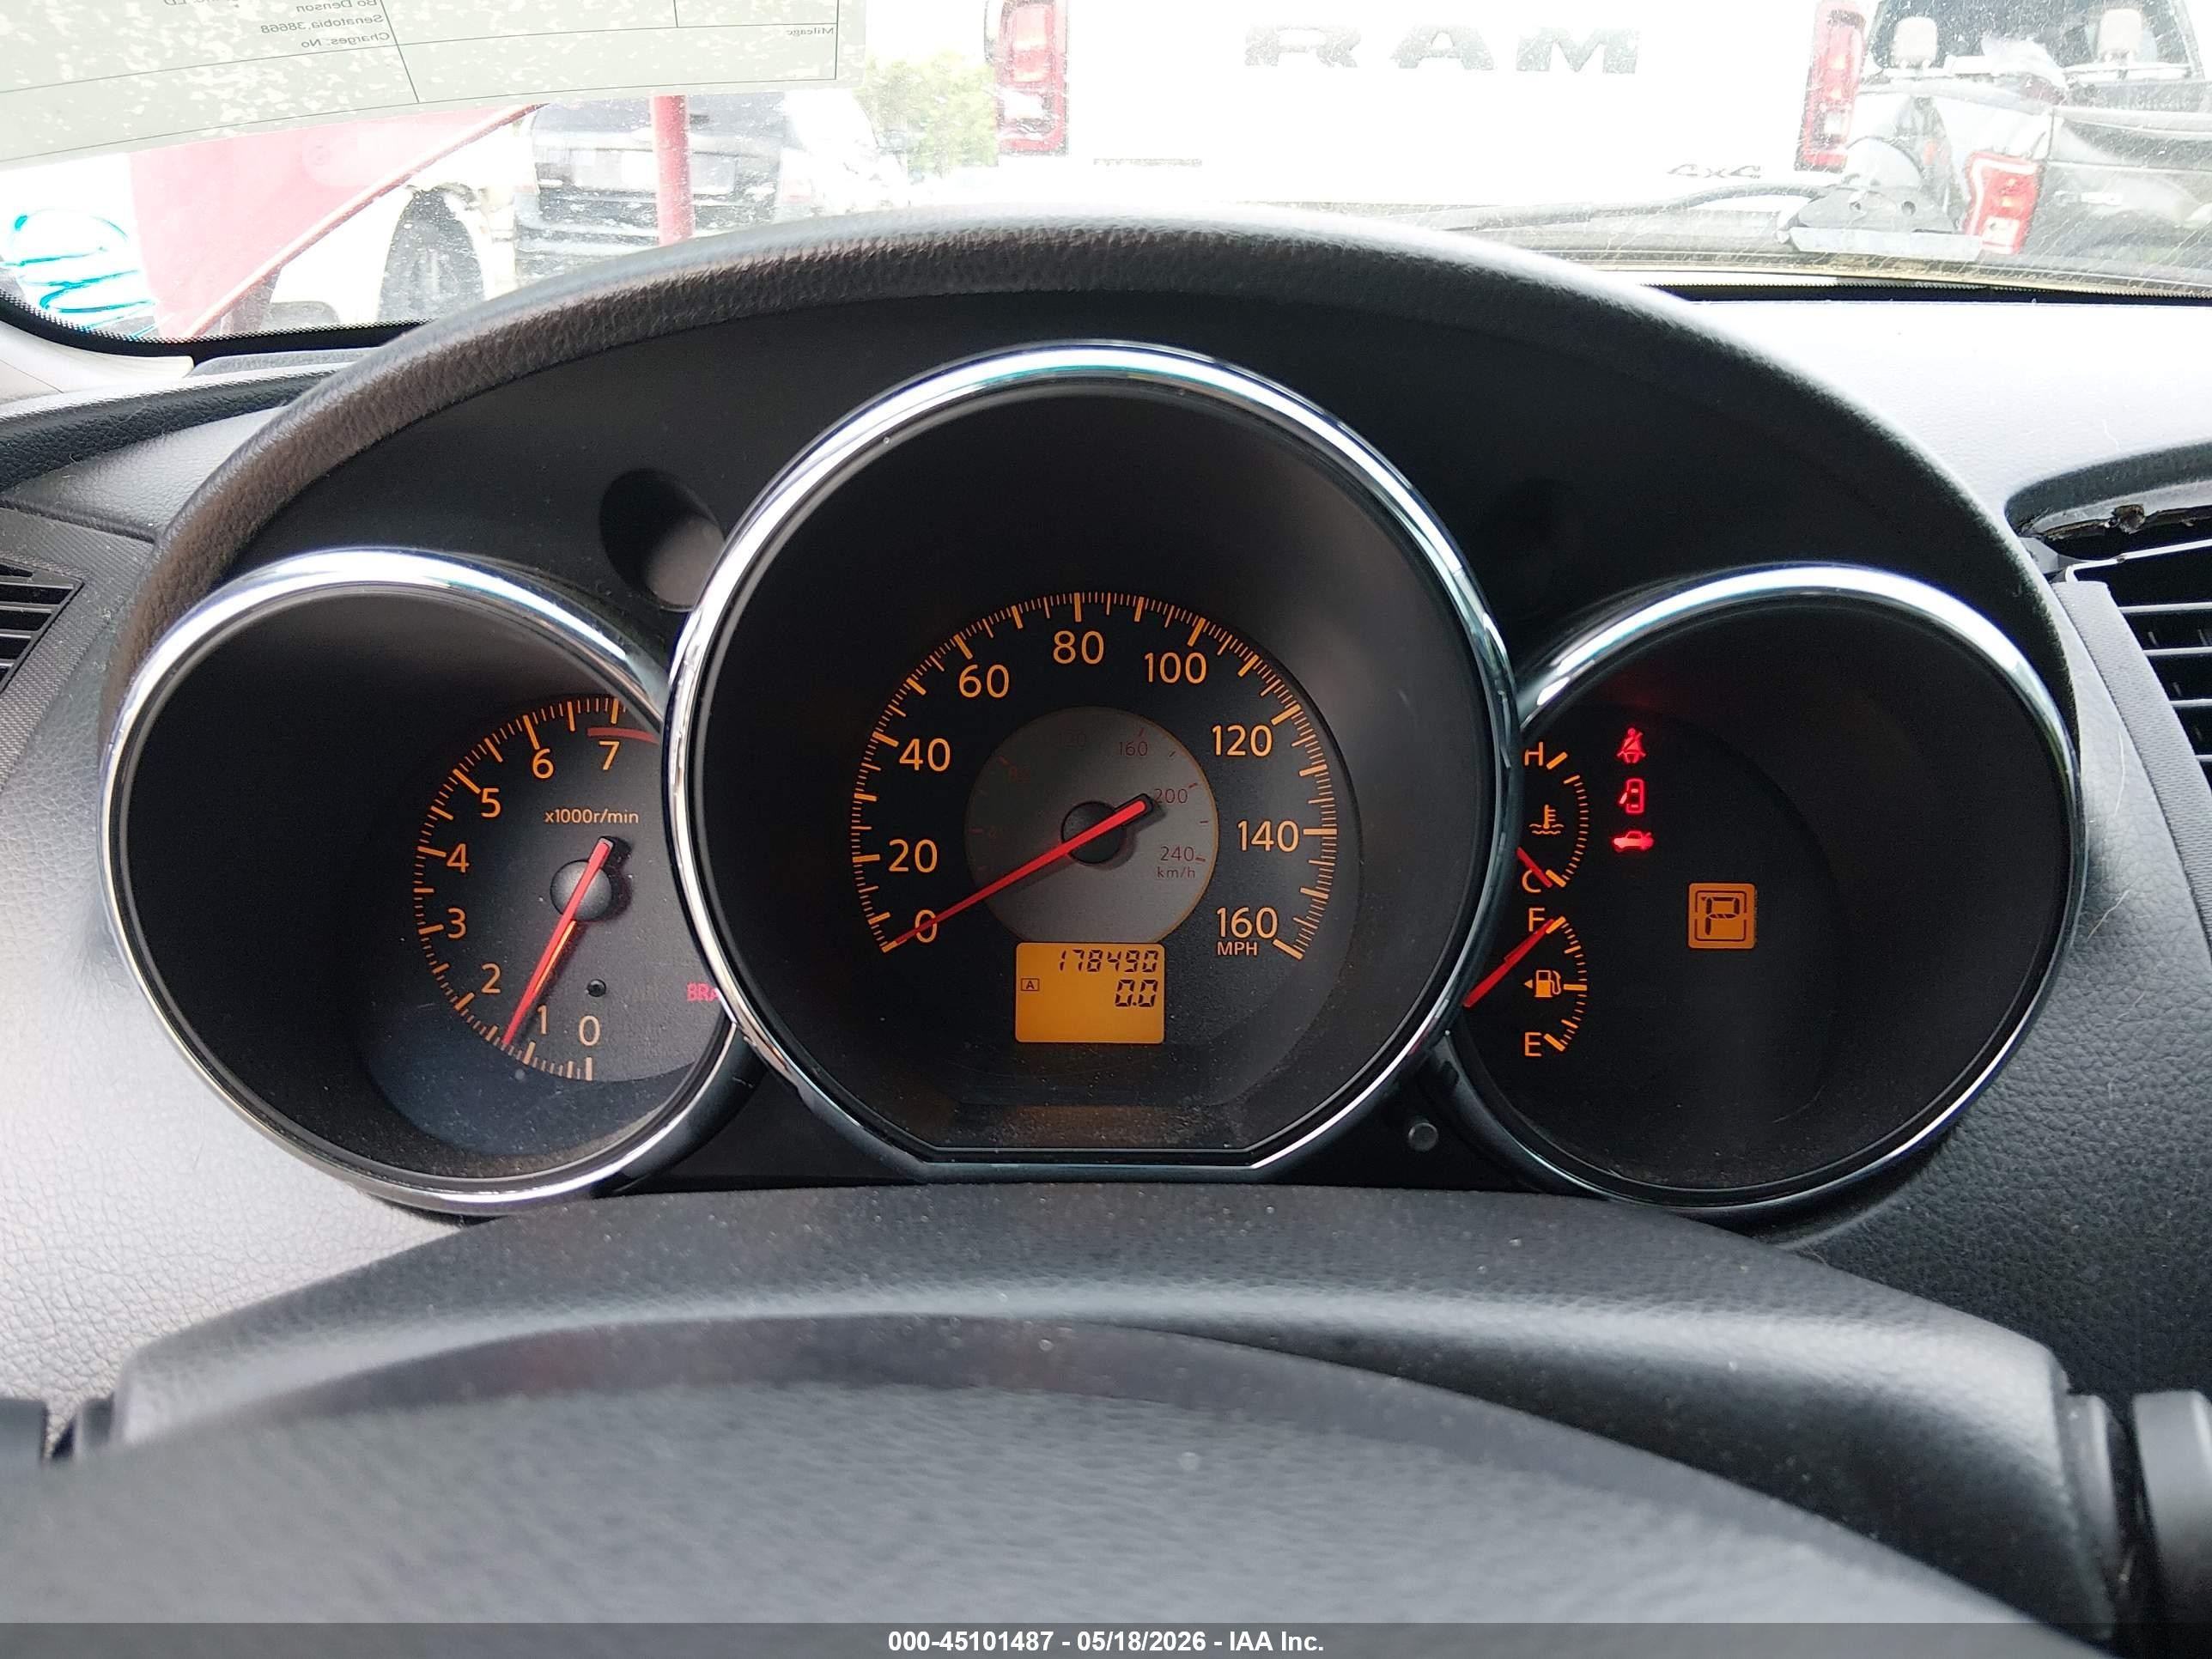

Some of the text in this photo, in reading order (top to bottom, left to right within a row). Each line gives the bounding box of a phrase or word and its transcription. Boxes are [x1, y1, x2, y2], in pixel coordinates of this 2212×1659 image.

[1243, 24, 1640, 74] RAM
[1052, 629, 1105, 665] 80
[958, 664, 1010, 698] 60
[1145, 652, 1207, 684] 100
[599, 740, 621, 771] 7
[898, 738, 951, 772] 40
[1119, 740, 1149, 757] 160
[1212, 724, 1273, 757] 120
[1524, 741, 1544, 767] H
[531, 746, 554, 780] 6
[479, 787, 501, 819] 5
[1153, 787, 1188, 805] 200
[544, 808, 640, 825] x1000r/min
[1237, 820, 1299, 853] 140
[446, 843, 470, 873] 4
[888, 838, 939, 873] 20
[1159, 845, 1195, 862] 240
[1156, 866, 1196, 879] km/h
[447, 907, 467, 939] 3
[914, 909, 939, 943] 0
[1217, 906, 1279, 939] 160
[1528, 907, 1546, 933] F
[1700, 896, 1741, 936] P
[1060, 949, 1159, 973] 178490
[1217, 940, 1259, 957] MPH
[481, 963, 501, 994] 2
[1115, 979, 1159, 1007] 0.0
[536, 1005, 549, 1034] 1
[578, 1015, 602, 1047] 0
[1524, 1031, 1542, 1058] E
